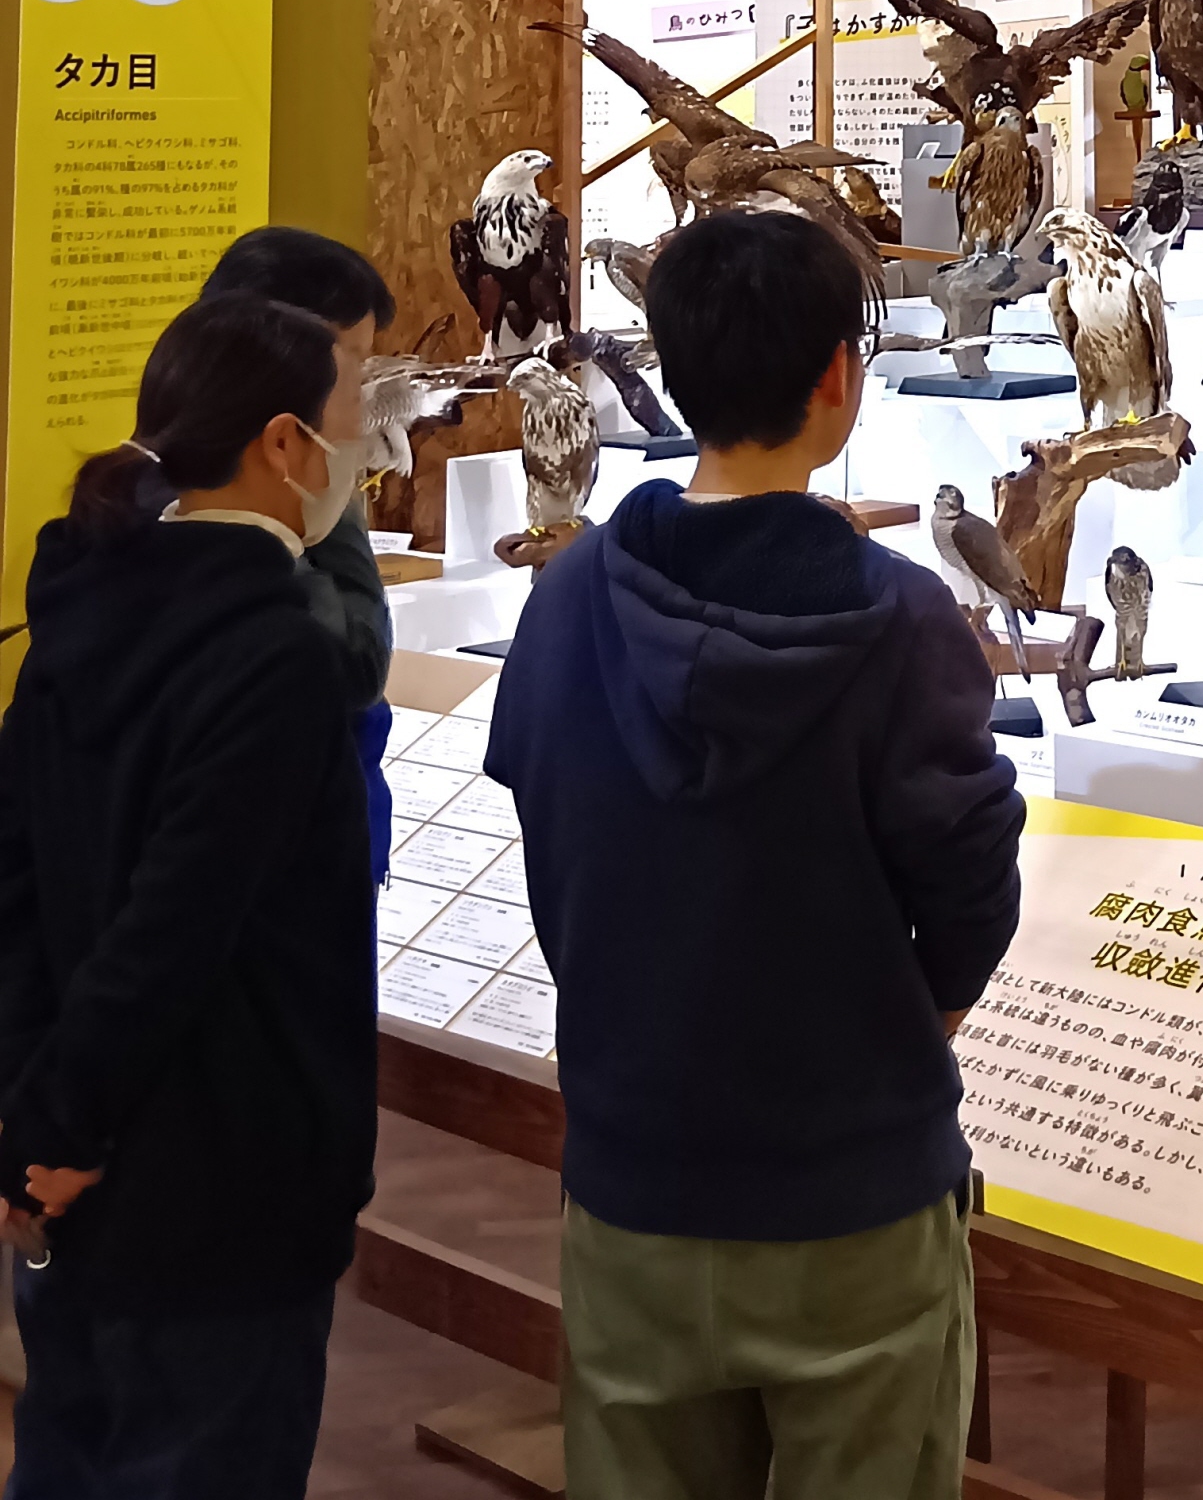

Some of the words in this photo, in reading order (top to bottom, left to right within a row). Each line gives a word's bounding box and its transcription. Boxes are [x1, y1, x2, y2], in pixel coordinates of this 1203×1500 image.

[669, 9, 743, 32] 鳥のひみつ
[54, 52, 158, 90] タカ目
[54, 108, 158, 123] Accipitriformes
